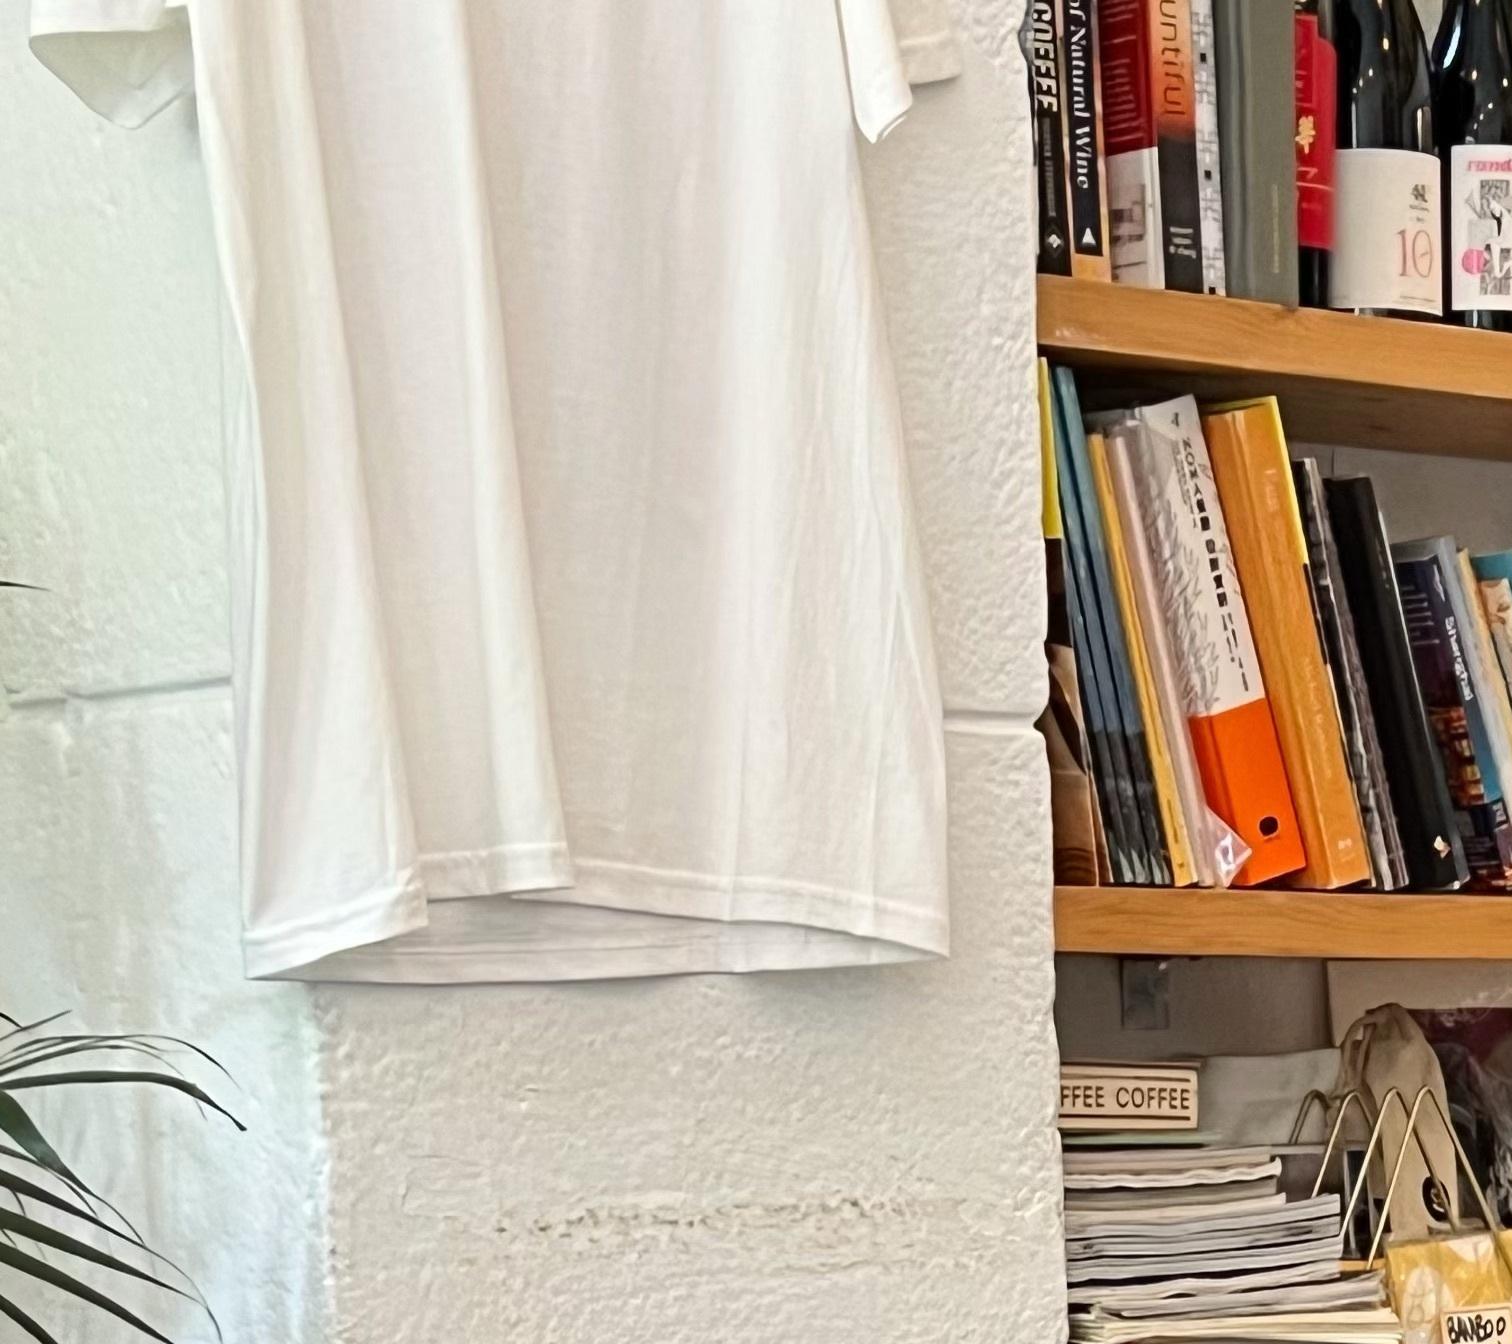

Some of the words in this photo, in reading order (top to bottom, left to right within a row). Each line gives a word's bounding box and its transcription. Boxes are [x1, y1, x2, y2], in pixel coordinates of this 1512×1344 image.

[1071, 25, 1091, 118] Natural
[1075, 126, 1093, 189] Wine
[1116, 1086, 1190, 1110] COFFEE
[1447, 1314, 1506, 1344] BAMBOO
